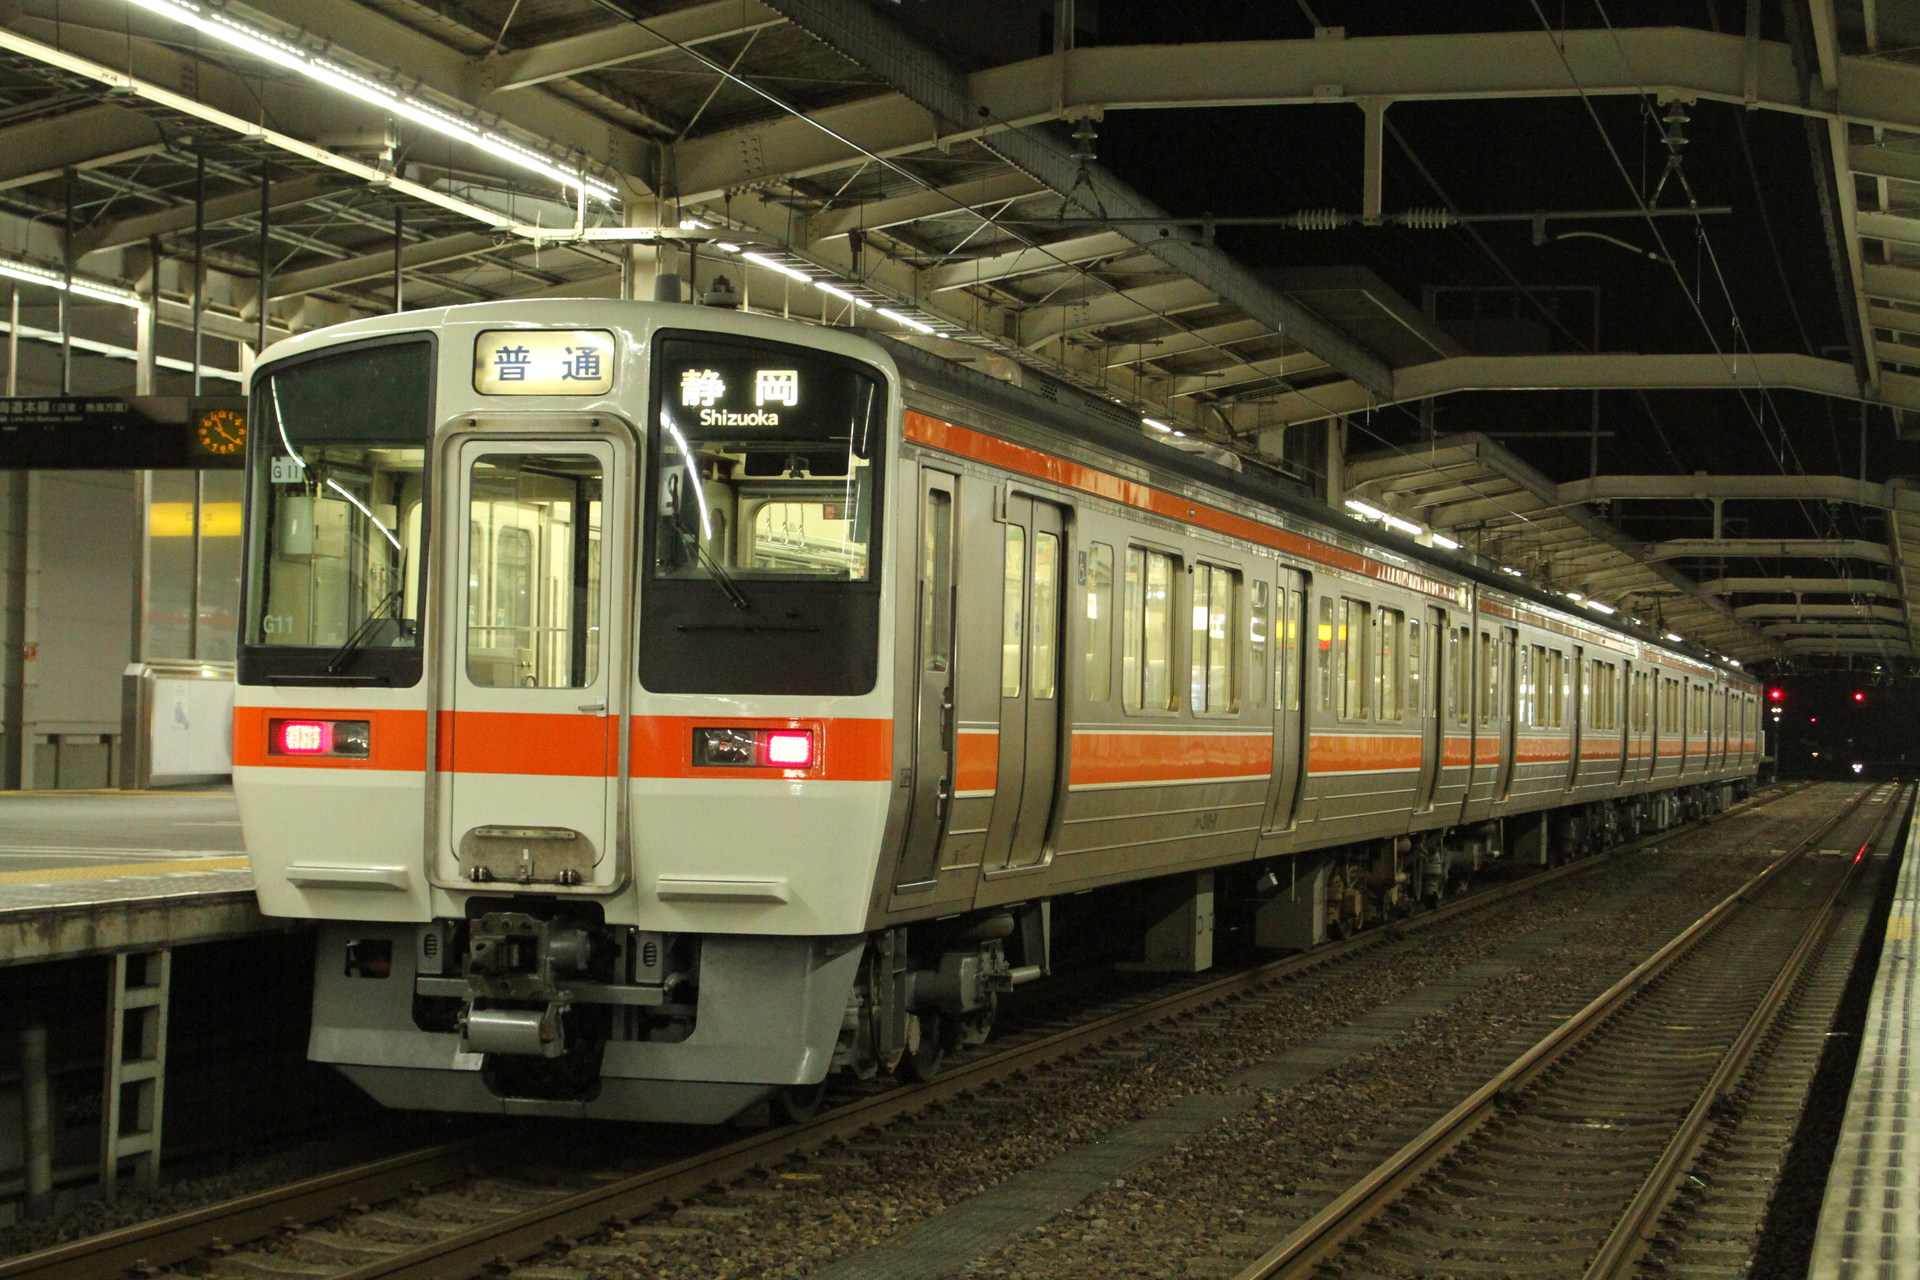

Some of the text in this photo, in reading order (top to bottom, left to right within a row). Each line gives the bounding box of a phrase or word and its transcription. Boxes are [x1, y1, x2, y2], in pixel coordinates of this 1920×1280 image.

[494, 346, 602, 381] 普通
[681, 369, 798, 406] 静岡
[700, 409, 779, 426] Shizuoka
[263, 614, 293, 634] G11
